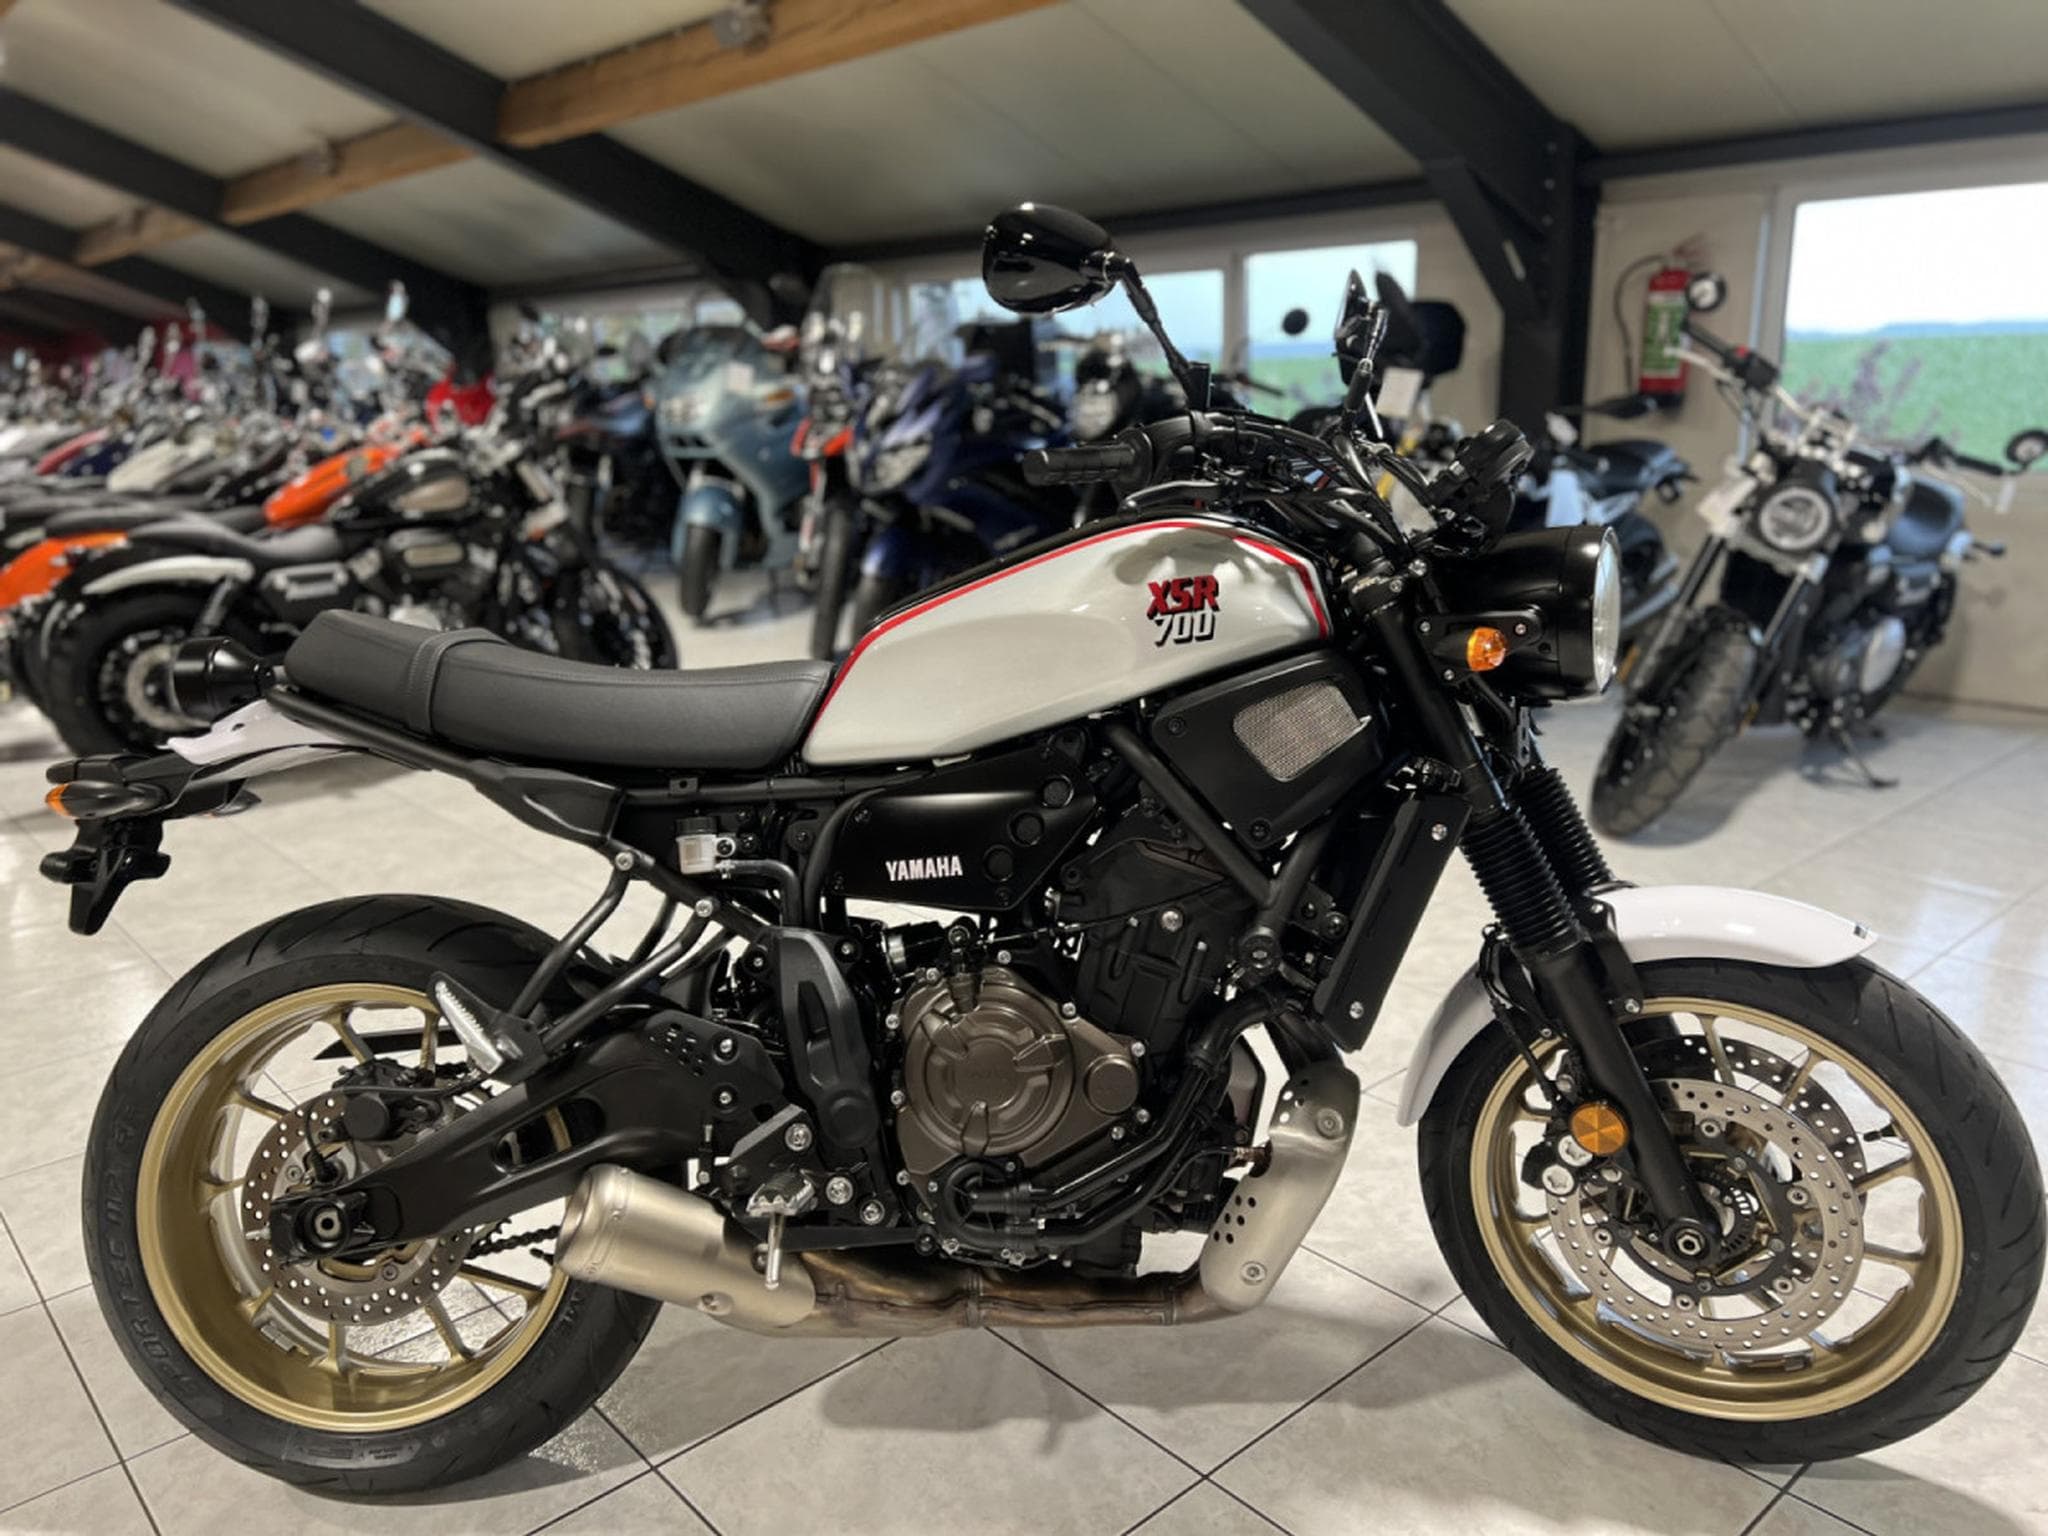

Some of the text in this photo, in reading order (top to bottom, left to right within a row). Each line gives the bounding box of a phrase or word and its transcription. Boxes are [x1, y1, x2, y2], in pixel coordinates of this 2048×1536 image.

[1147, 574, 1220, 620] XSR
[1154, 610, 1215, 647] 700
[885, 855, 963, 881] YAMAHA
